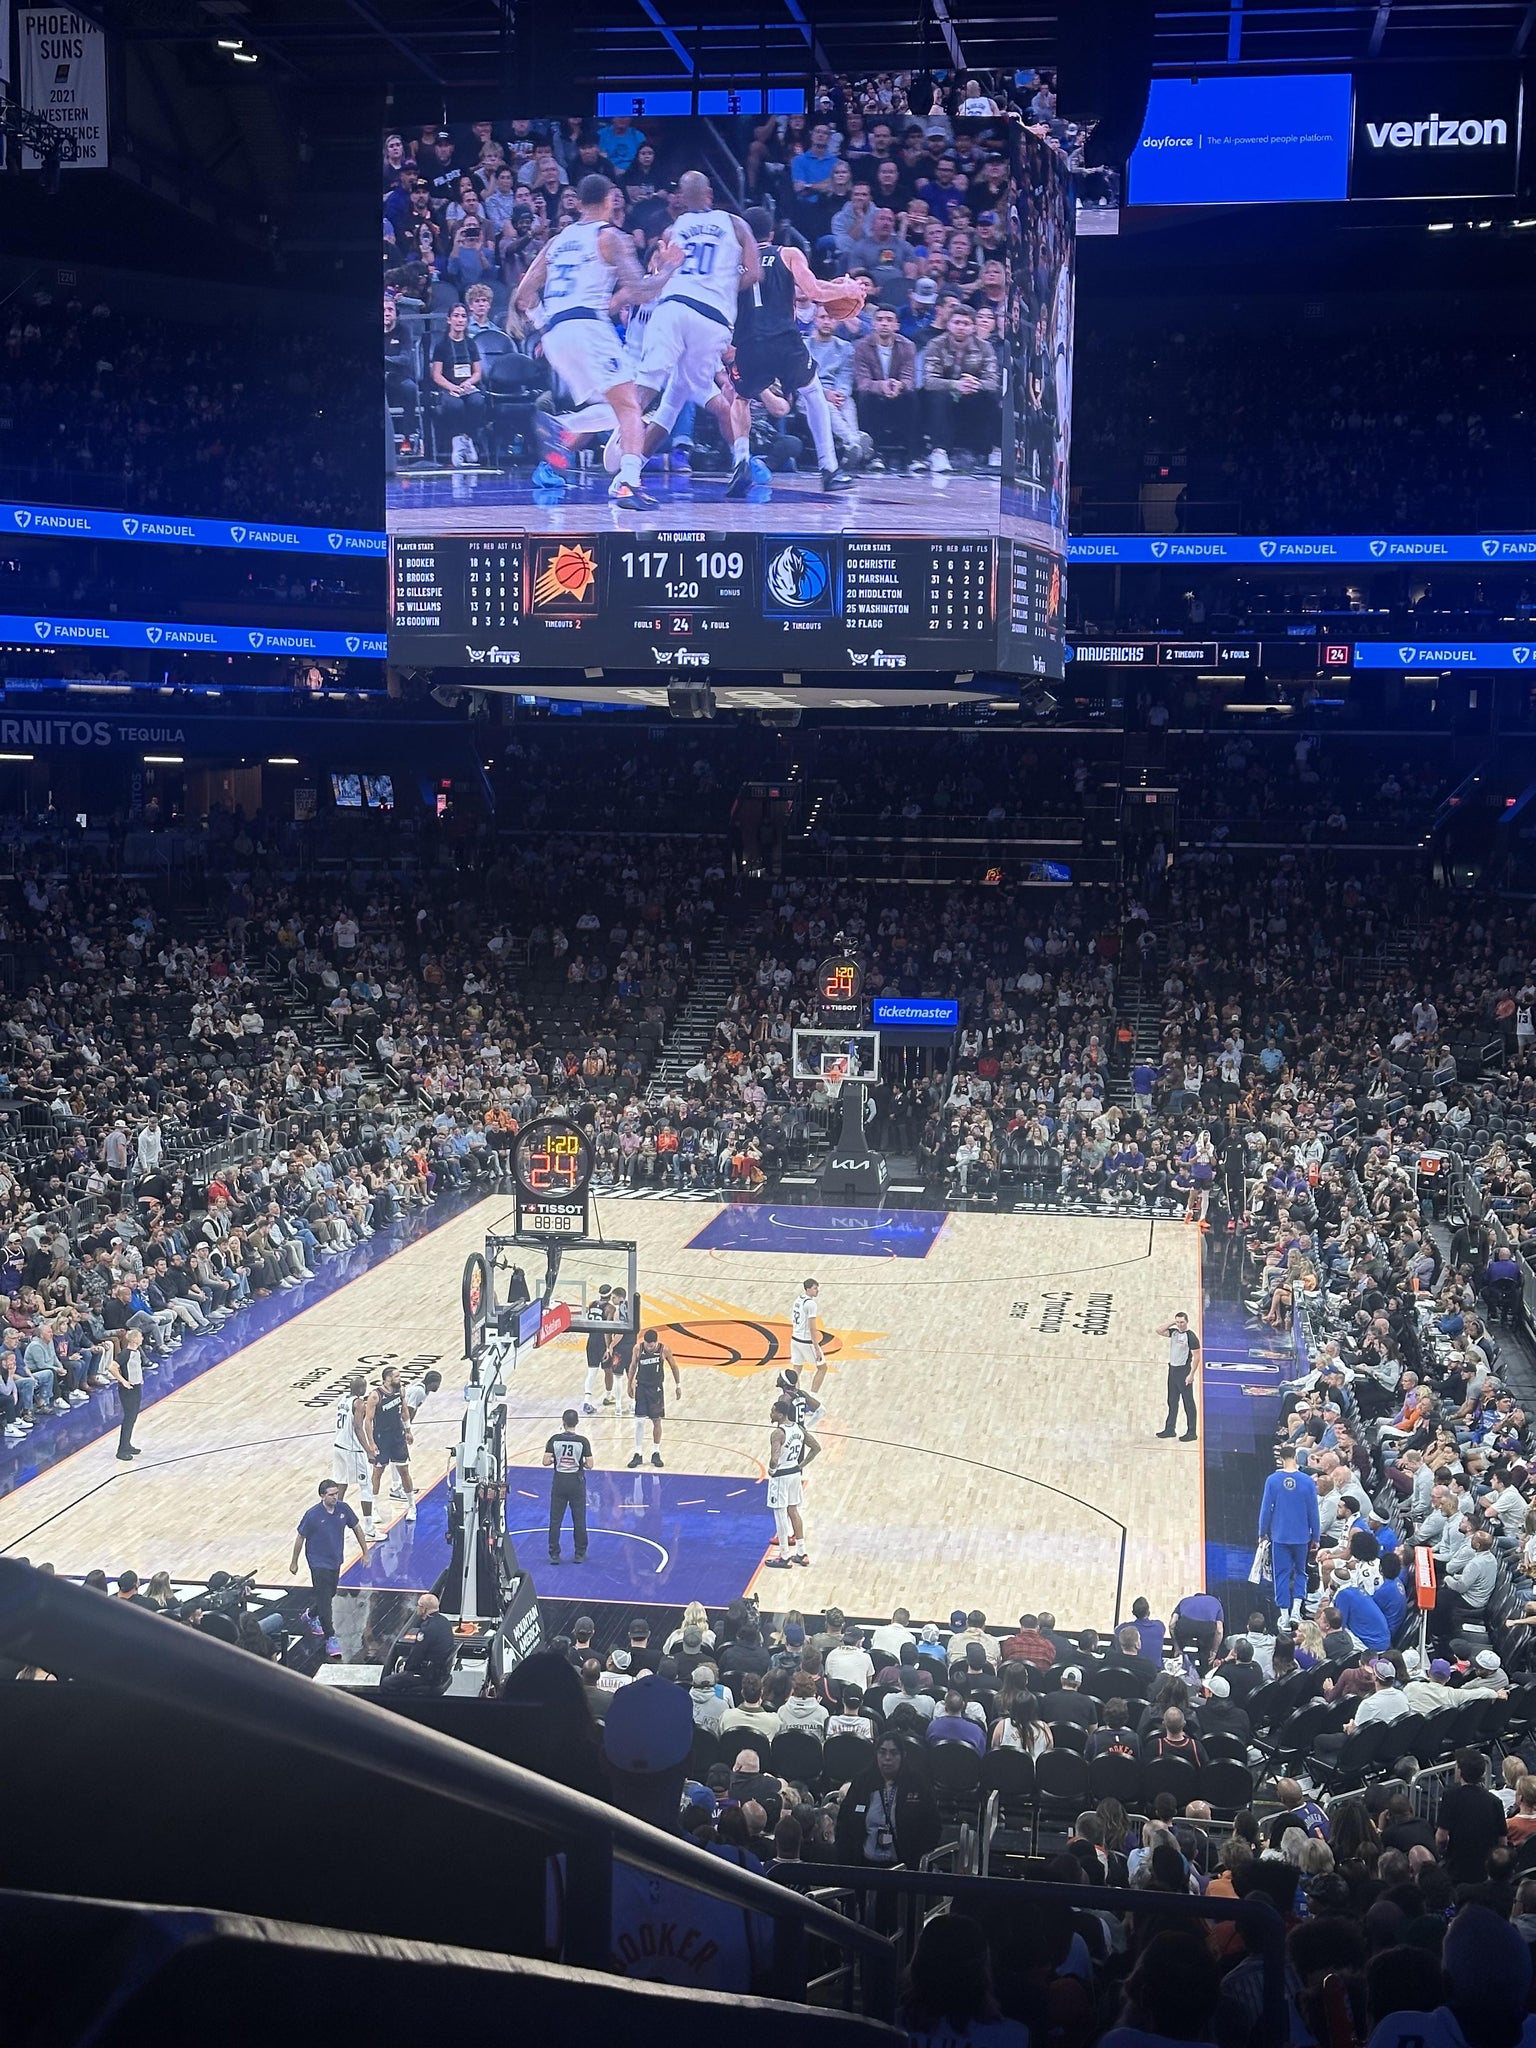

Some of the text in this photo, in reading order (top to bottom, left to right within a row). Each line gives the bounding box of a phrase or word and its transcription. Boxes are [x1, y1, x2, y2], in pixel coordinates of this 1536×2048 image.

[40, 39, 83, 60] SUNS
[50, 89, 75, 103] 2021
[38, 107, 89, 122] WESTERN
[1366, 113, 1507, 149] verizon
[1143, 136, 1194, 150] dayforce
[1207, 136, 1222, 145] The
[1223, 134, 1269, 147] AI-powered
[1270, 134, 1298, 146] people
[34, 514, 91, 530] FANDUEL
[141, 522, 196, 537] FANDUEL
[248, 530, 300, 545] FANDUEL
[657, 533, 706, 543] 4TH QUARTER
[848, 543, 872, 552] PLAYER
[872, 543, 892, 552] STATS
[1170, 543, 1227, 556] FANDUEL
[1279, 543, 1337, 556] FANDUEL
[1390, 542, 1448, 556] FANDUEL
[398, 558, 403, 568] 1
[406, 558, 435, 568] BOOKER
[484, 558, 491, 568] 4
[512, 558, 519, 568] 4
[621, 552, 669, 578] 117
[695, 552, 744, 579] 109
[859, 559, 896, 569] CHRISTIE
[932, 560, 939, 570] 5
[964, 560, 970, 570] 3
[978, 560, 985, 570] 2
[397, 572, 519, 582] 3 BROOKS 21 3 1 3
[847, 574, 984, 584] 13 MARSHALL 31 4 2 0
[396, 587, 405, 597] 12
[406, 587, 443, 597] GILLESPIE
[471, 587, 478, 597] 5
[485, 587, 491, 597] 8
[513, 587, 519, 597] 3
[664, 582, 699, 598] 1:20
[719, 588, 741, 597] BONUS
[846, 589, 984, 600] 20 MIDDLETON 13 2 2
[396, 601, 519, 612] 15 WILLIAMS 13 7 1 0
[846, 604, 984, 614] 25 WASHINGTON 11 5 1 0
[396, 616, 519, 626] 23 GOODWIN 8 3 2 4
[544, 619, 581, 630] TIMEOUTS 2
[633, 619, 662, 630] FOULS 5
[673, 618, 689, 632] 24
[701, 620, 730, 630] 4 FOULS
[783, 621, 822, 631] 2 TIMEOUTS
[846, 619, 983, 630] 32 FLAGG 27 5 2 0
[54, 625, 110, 639] FANDUEL
[164, 631, 217, 644] FANDUEL
[266, 636, 316, 649] FANDUEL
[486, 645, 520, 664] fry's
[674, 647, 710, 666] fry's
[870, 648, 907, 668] fry's
[1076, 647, 1144, 662] MAVERICKS
[1166, 649, 1204, 660] 2 TIMEOUTS
[1221, 649, 1250, 660] 4 FOULS
[1331, 649, 1345, 661] 24
[1419, 649, 1477, 662] FANDUEL
[0, 718, 186, 746] RNITOS TEQUILA
[835, 967, 854, 978] 1:20
[826, 977, 852, 997] 24
[878, 1005, 953, 1019] ticketmaster
[547, 1135, 579, 1154] 1:20
[1426, 1159, 1434, 1168] G
[531, 1153, 576, 1188] 24
[537, 1204, 584, 1214] TISSOT
[1009, 1301, 1030, 1320] center
[1072, 1292, 1118, 1336] mortgage
[1030, 1301, 1070, 1334] matchup
[289, 1366, 333, 1390] center
[562, 1444, 574, 1456] 73
[786, 1444, 801, 1462] 25
[512, 1604, 540, 1642] MOUNTAIN
[518, 1621, 542, 1656] AMERICA
